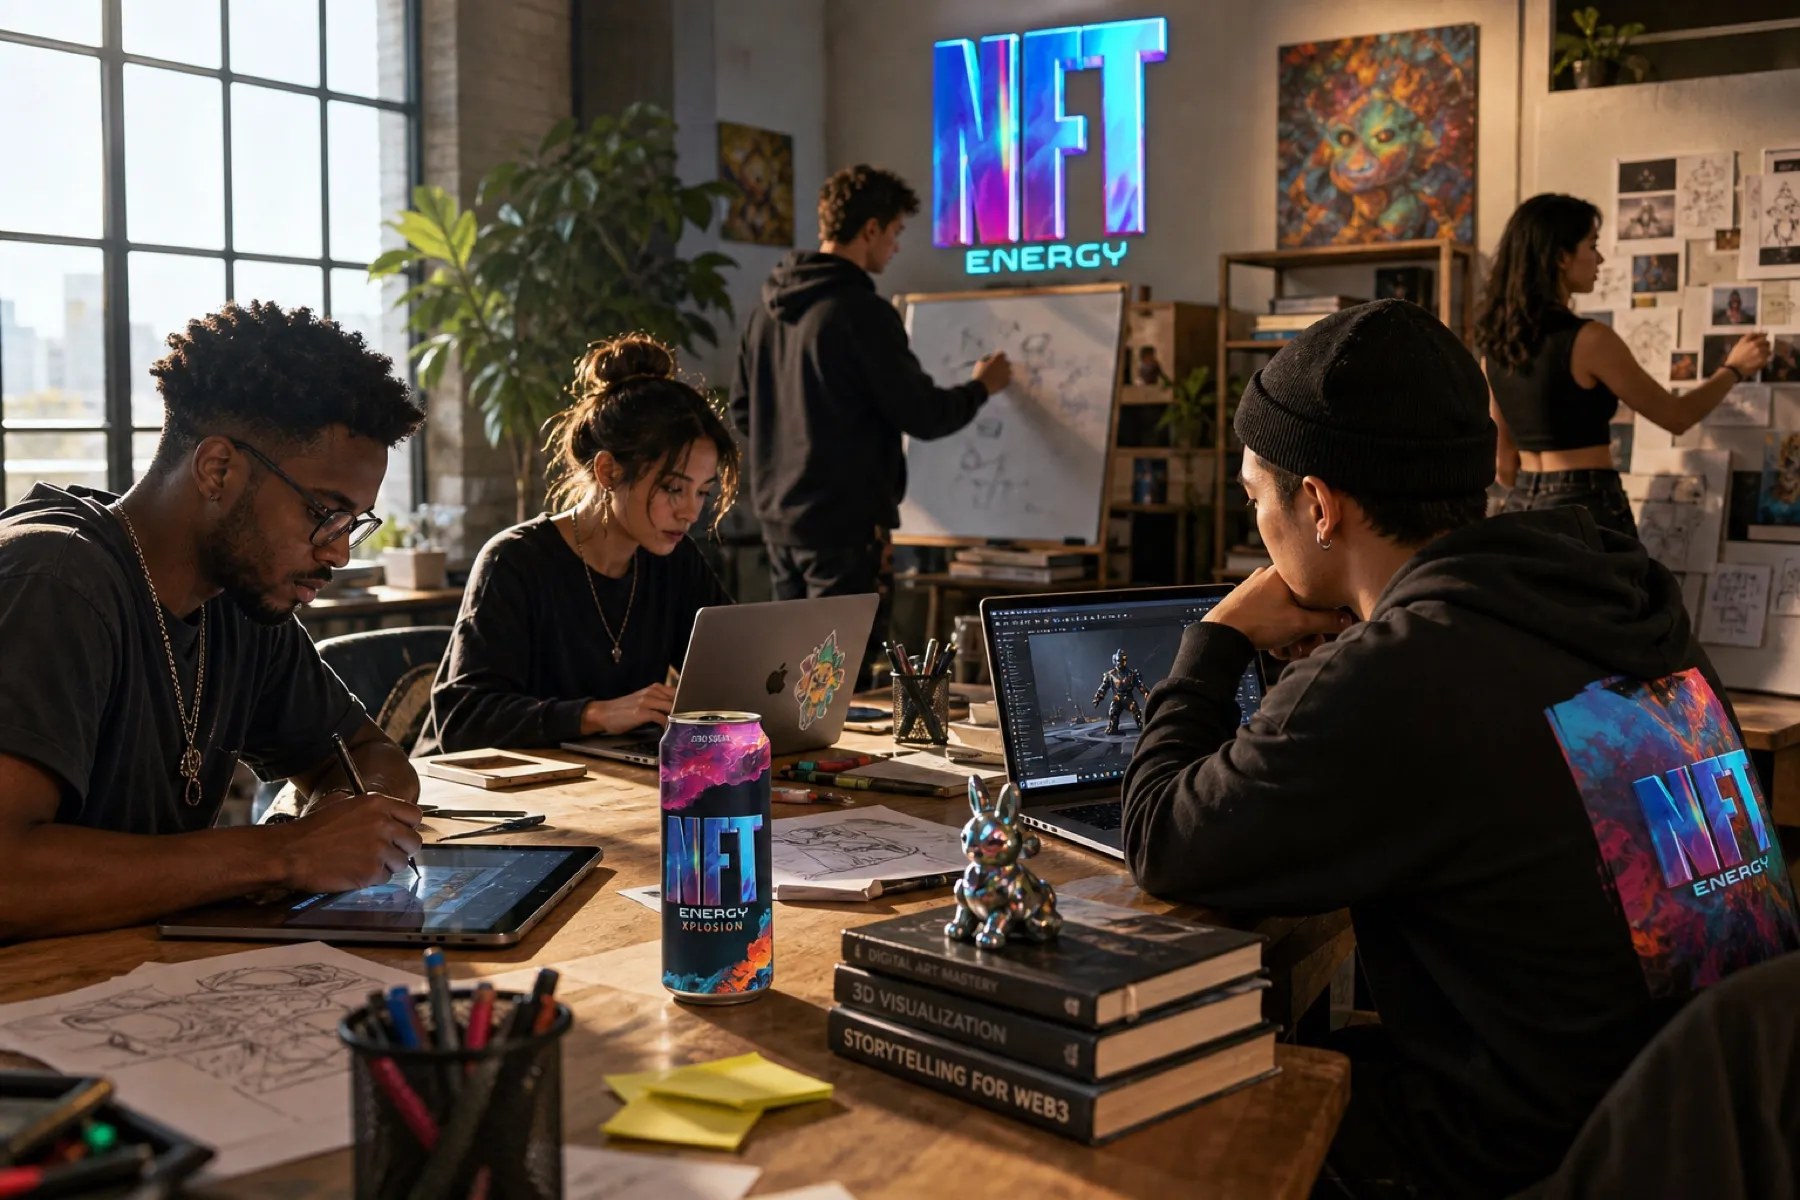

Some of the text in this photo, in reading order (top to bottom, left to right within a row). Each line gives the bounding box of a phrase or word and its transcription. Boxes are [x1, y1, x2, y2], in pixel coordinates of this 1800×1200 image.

[932, 17, 1167, 247] NFT
[965, 241, 1128, 274] ENERGY
[1633, 749, 1771, 888] NFT
[666, 814, 763, 906] NFT
[1693, 855, 1769, 897] ENERGY
[679, 907, 749, 919] ENERGY
[682, 921, 743, 932] XPLOSION
[868, 949, 999, 993] DIGITAL ART MASTERY
[852, 982, 1007, 1044] 3D VISUALIZATION
[844, 1028, 1069, 1123] STORYTELLING FOR WEB3
